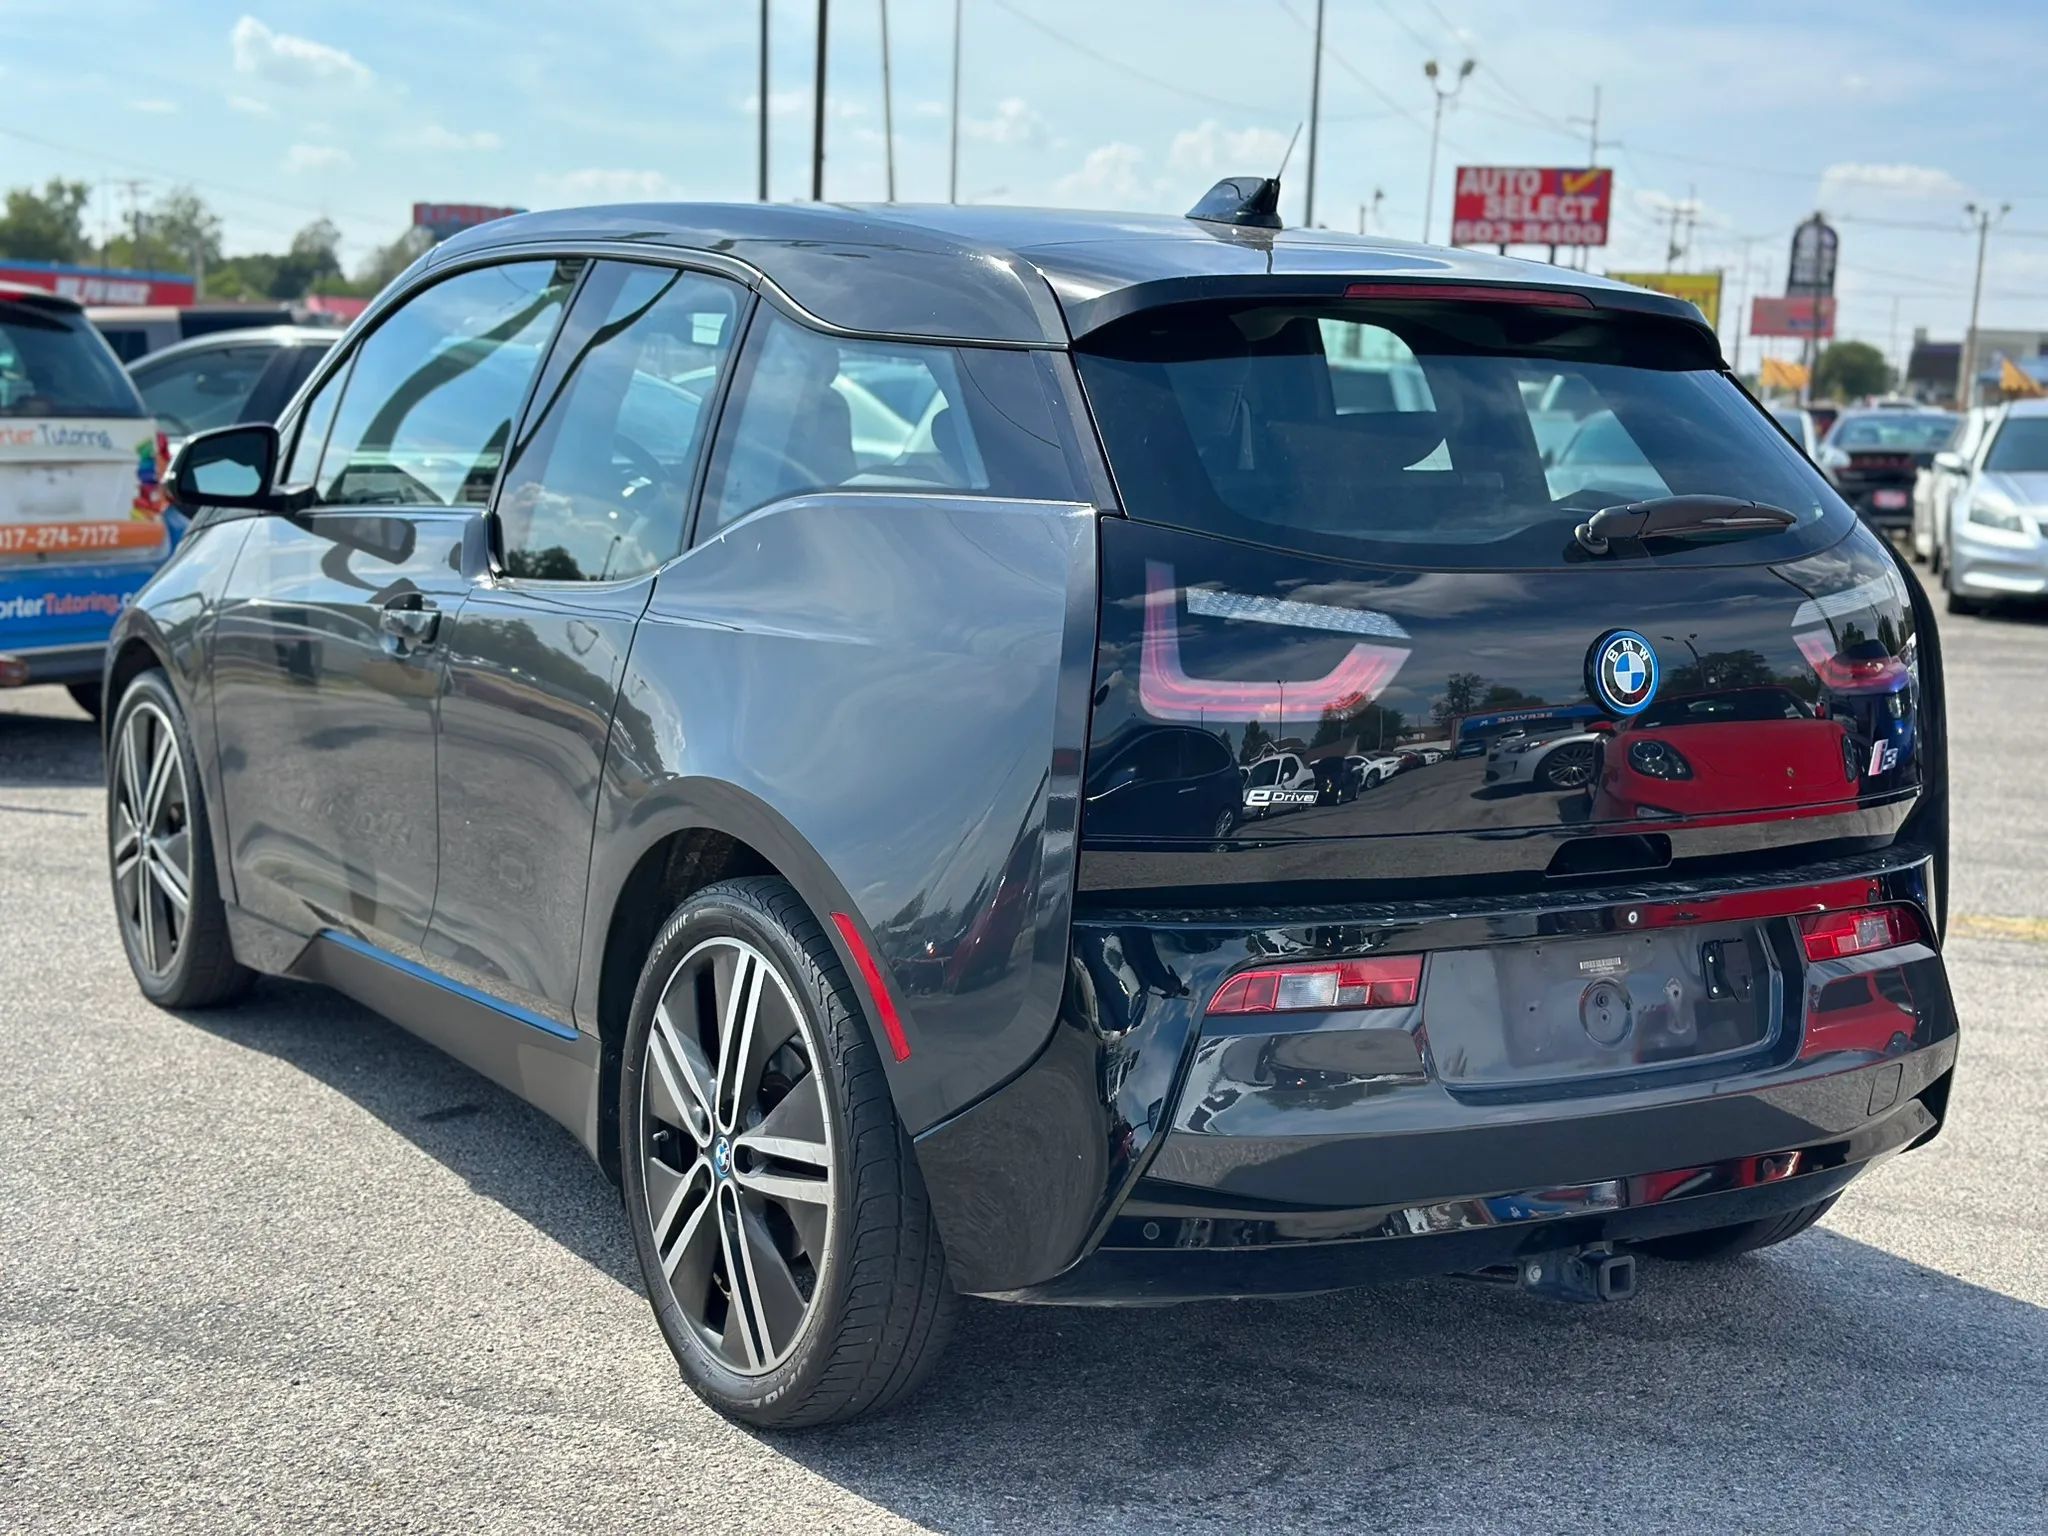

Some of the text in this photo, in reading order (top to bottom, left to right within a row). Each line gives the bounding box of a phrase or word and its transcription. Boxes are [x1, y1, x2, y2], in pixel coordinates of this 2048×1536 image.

[1459, 168, 1542, 197] AUTO
[1483, 194, 1598, 221] SELECT
[38, 423, 112, 449] Tutoring
[1607, 640, 1649, 662] BMW
